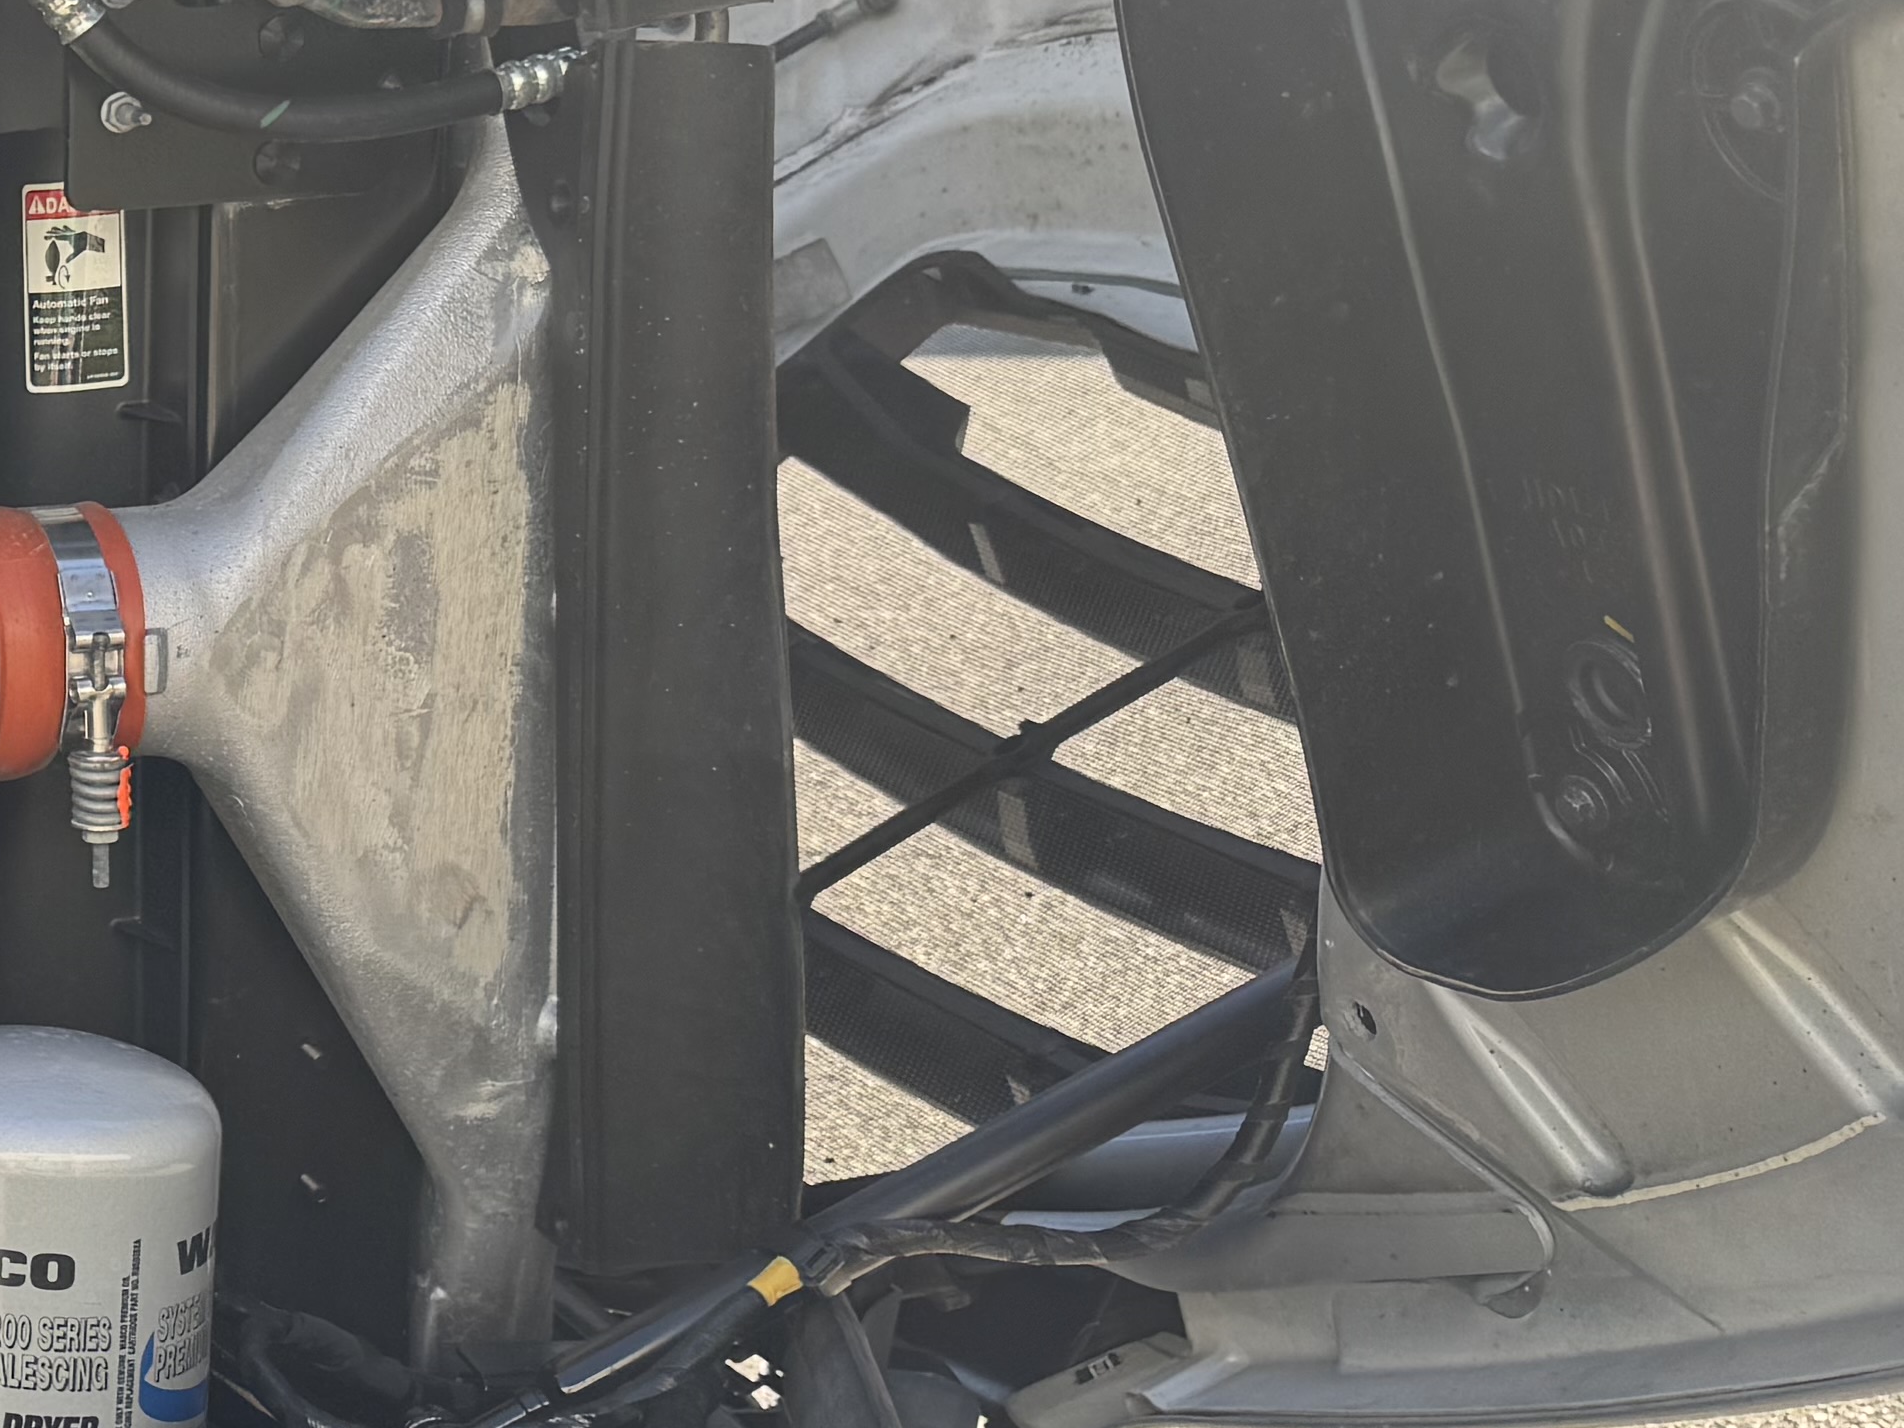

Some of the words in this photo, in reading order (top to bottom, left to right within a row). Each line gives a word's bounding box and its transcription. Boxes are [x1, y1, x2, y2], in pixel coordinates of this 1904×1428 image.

[33, 298, 87, 310] Automatic
[90, 296, 109, 306] Fan
[37, 1315, 112, 1353] SERIES
